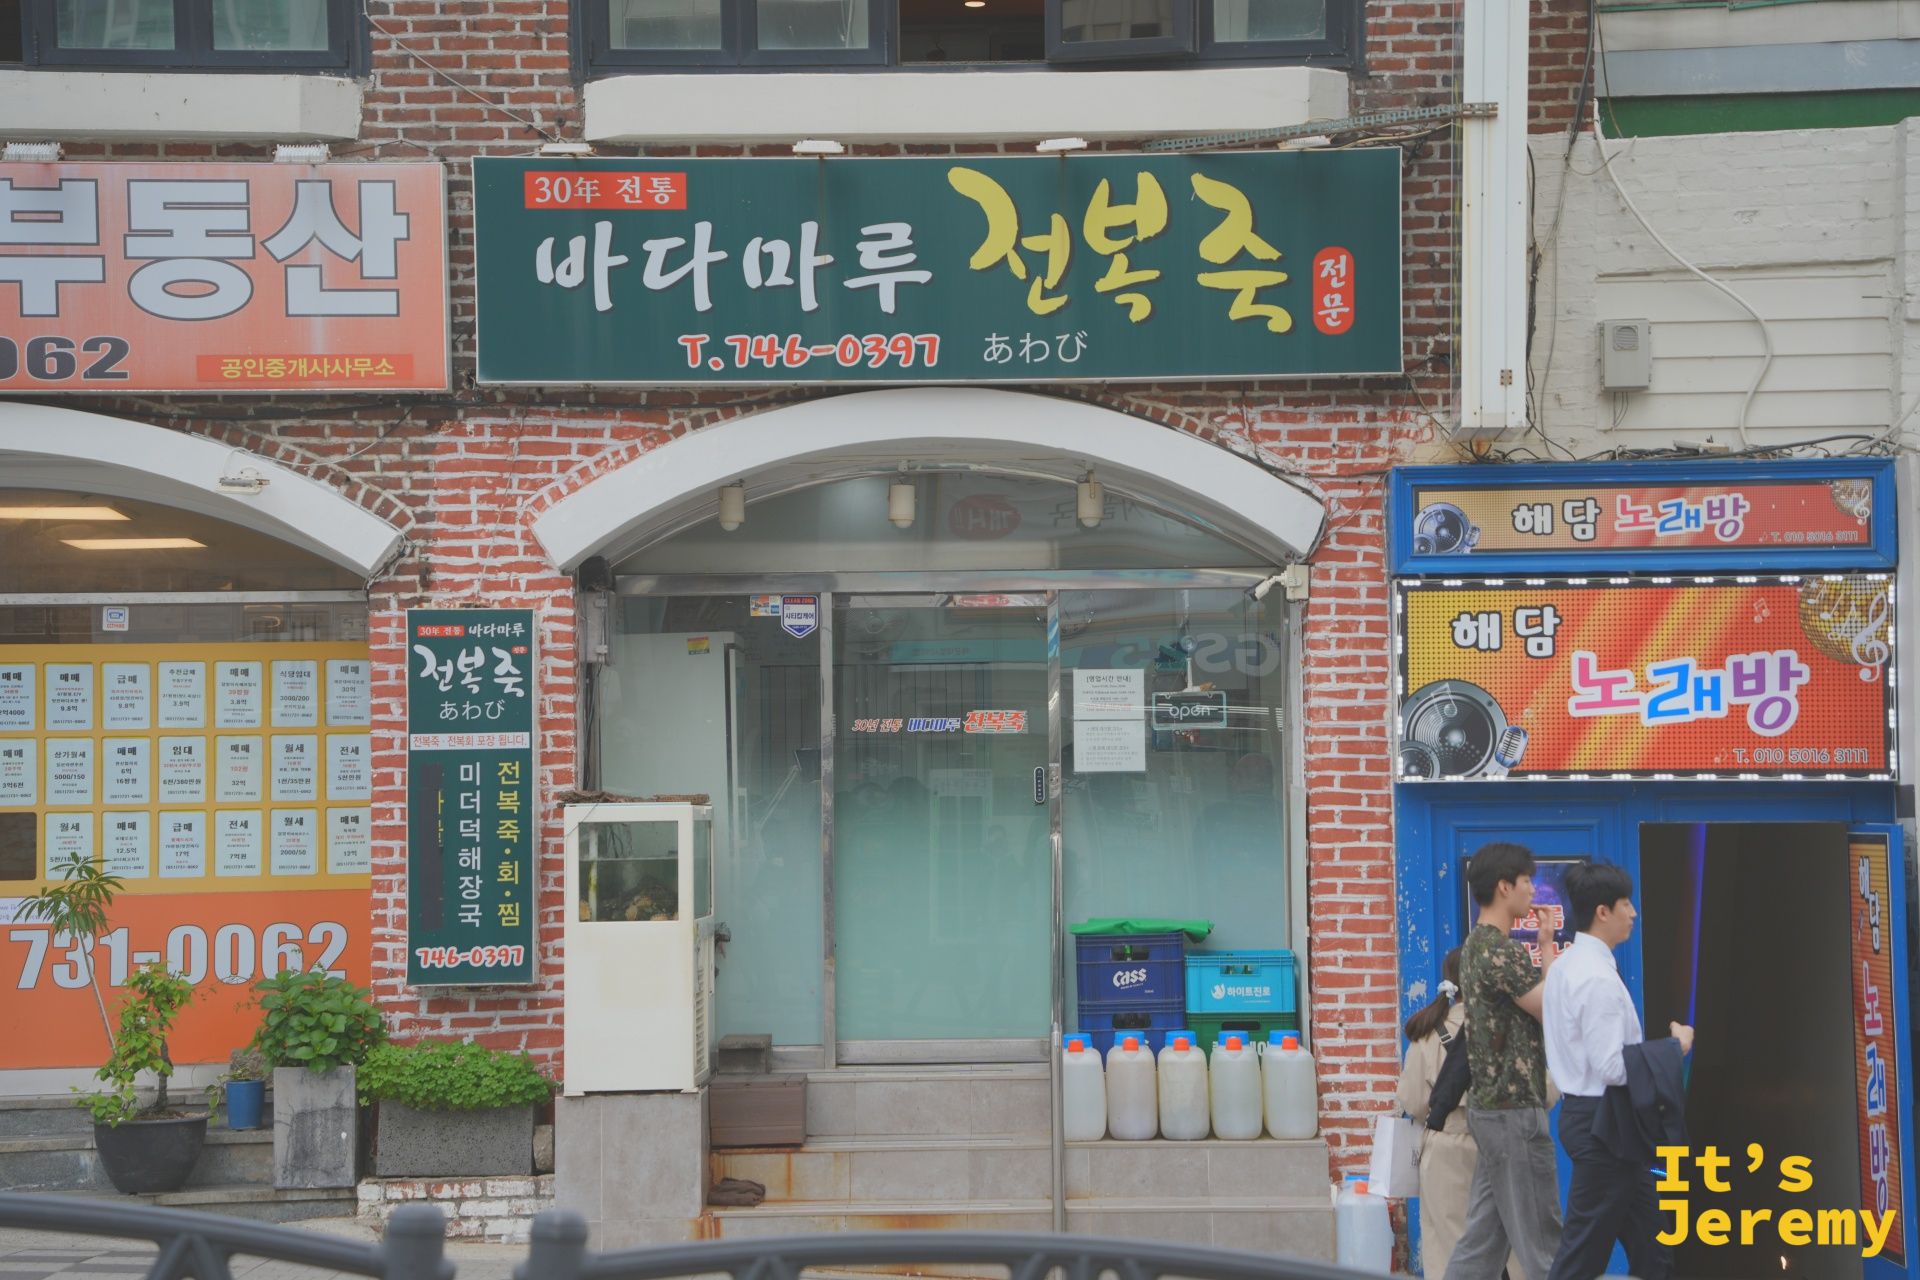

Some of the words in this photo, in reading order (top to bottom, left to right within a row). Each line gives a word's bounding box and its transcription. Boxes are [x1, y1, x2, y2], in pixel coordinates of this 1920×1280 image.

[533, 175, 602, 205] 30年
[615, 175, 678, 206] 전통
[0, 177, 411, 322] 부동산
[534, 219, 934, 315] 바다마루
[946, 165, 1293, 334] 전복죽
[1317, 254, 1351, 328] 전문
[677, 332, 941, 372] T.746-0397
[982, 329, 1089, 364] あわび
[219, 357, 397, 379] 공인중개사사무소
[1614, 493, 1751, 542] 노래방
[1770, 531, 1781, 542] T.
[1783, 531, 1804, 542] 010
[1806, 530, 1834, 542] 5016
[1835, 530, 1858, 541] 3111
[420, 626, 440, 636] 30年
[443, 626, 462, 636] 전통
[468, 622, 526, 638] 바다마루
[230, 667, 250, 677] 매매
[280, 670, 311, 678] 식당임대
[340, 665, 360, 674] 매매
[413, 643, 525, 698] 전복죽
[2, 671, 22, 682] 매매
[60, 673, 80, 682] 매매
[116, 674, 138, 684] 급매
[1568, 649, 1810, 738] 노래방
[438, 699, 506, 722] あわび
[1169, 705, 1211, 721] open
[851, 719, 880, 733] 30년
[879, 718, 904, 733] 전통
[907, 717, 961, 732] 바다마루
[964, 710, 1026, 733] 전복죽
[413, 735, 440, 748] 전복죽
[447, 735, 474, 748] 전복회
[476, 735, 495, 747] 포장
[497, 734, 528, 747] 됩니다.
[3, 748, 24, 758] 매매
[116, 746, 137, 756] 매매
[172, 745, 193, 755] 임대
[230, 743, 250, 753] 매매
[284, 743, 305, 753] 월세
[340, 745, 360, 756] 전세
[54, 751, 86, 759] 상가월세
[1732, 748, 1750, 764] T.
[1753, 747, 1784, 764] 010
[1788, 747, 1830, 764] 5016
[1833, 747, 1868, 764] 3111
[116, 821, 137, 831] 매매
[229, 819, 249, 829] 전세
[284, 816, 304, 826] 월세
[340, 815, 360, 824] 매매
[59, 822, 80, 832] 월세
[172, 822, 193, 832] 급매
[457, 761, 483, 928] 미더덕해장국
[9, 920, 350, 990] 731-0062
[414, 944, 525, 969] 746-0397
[1112, 967, 1147, 988] Cass
[1227, 985, 1272, 998] 하이트진로
[1862, 960, 1891, 1222] 노래방
